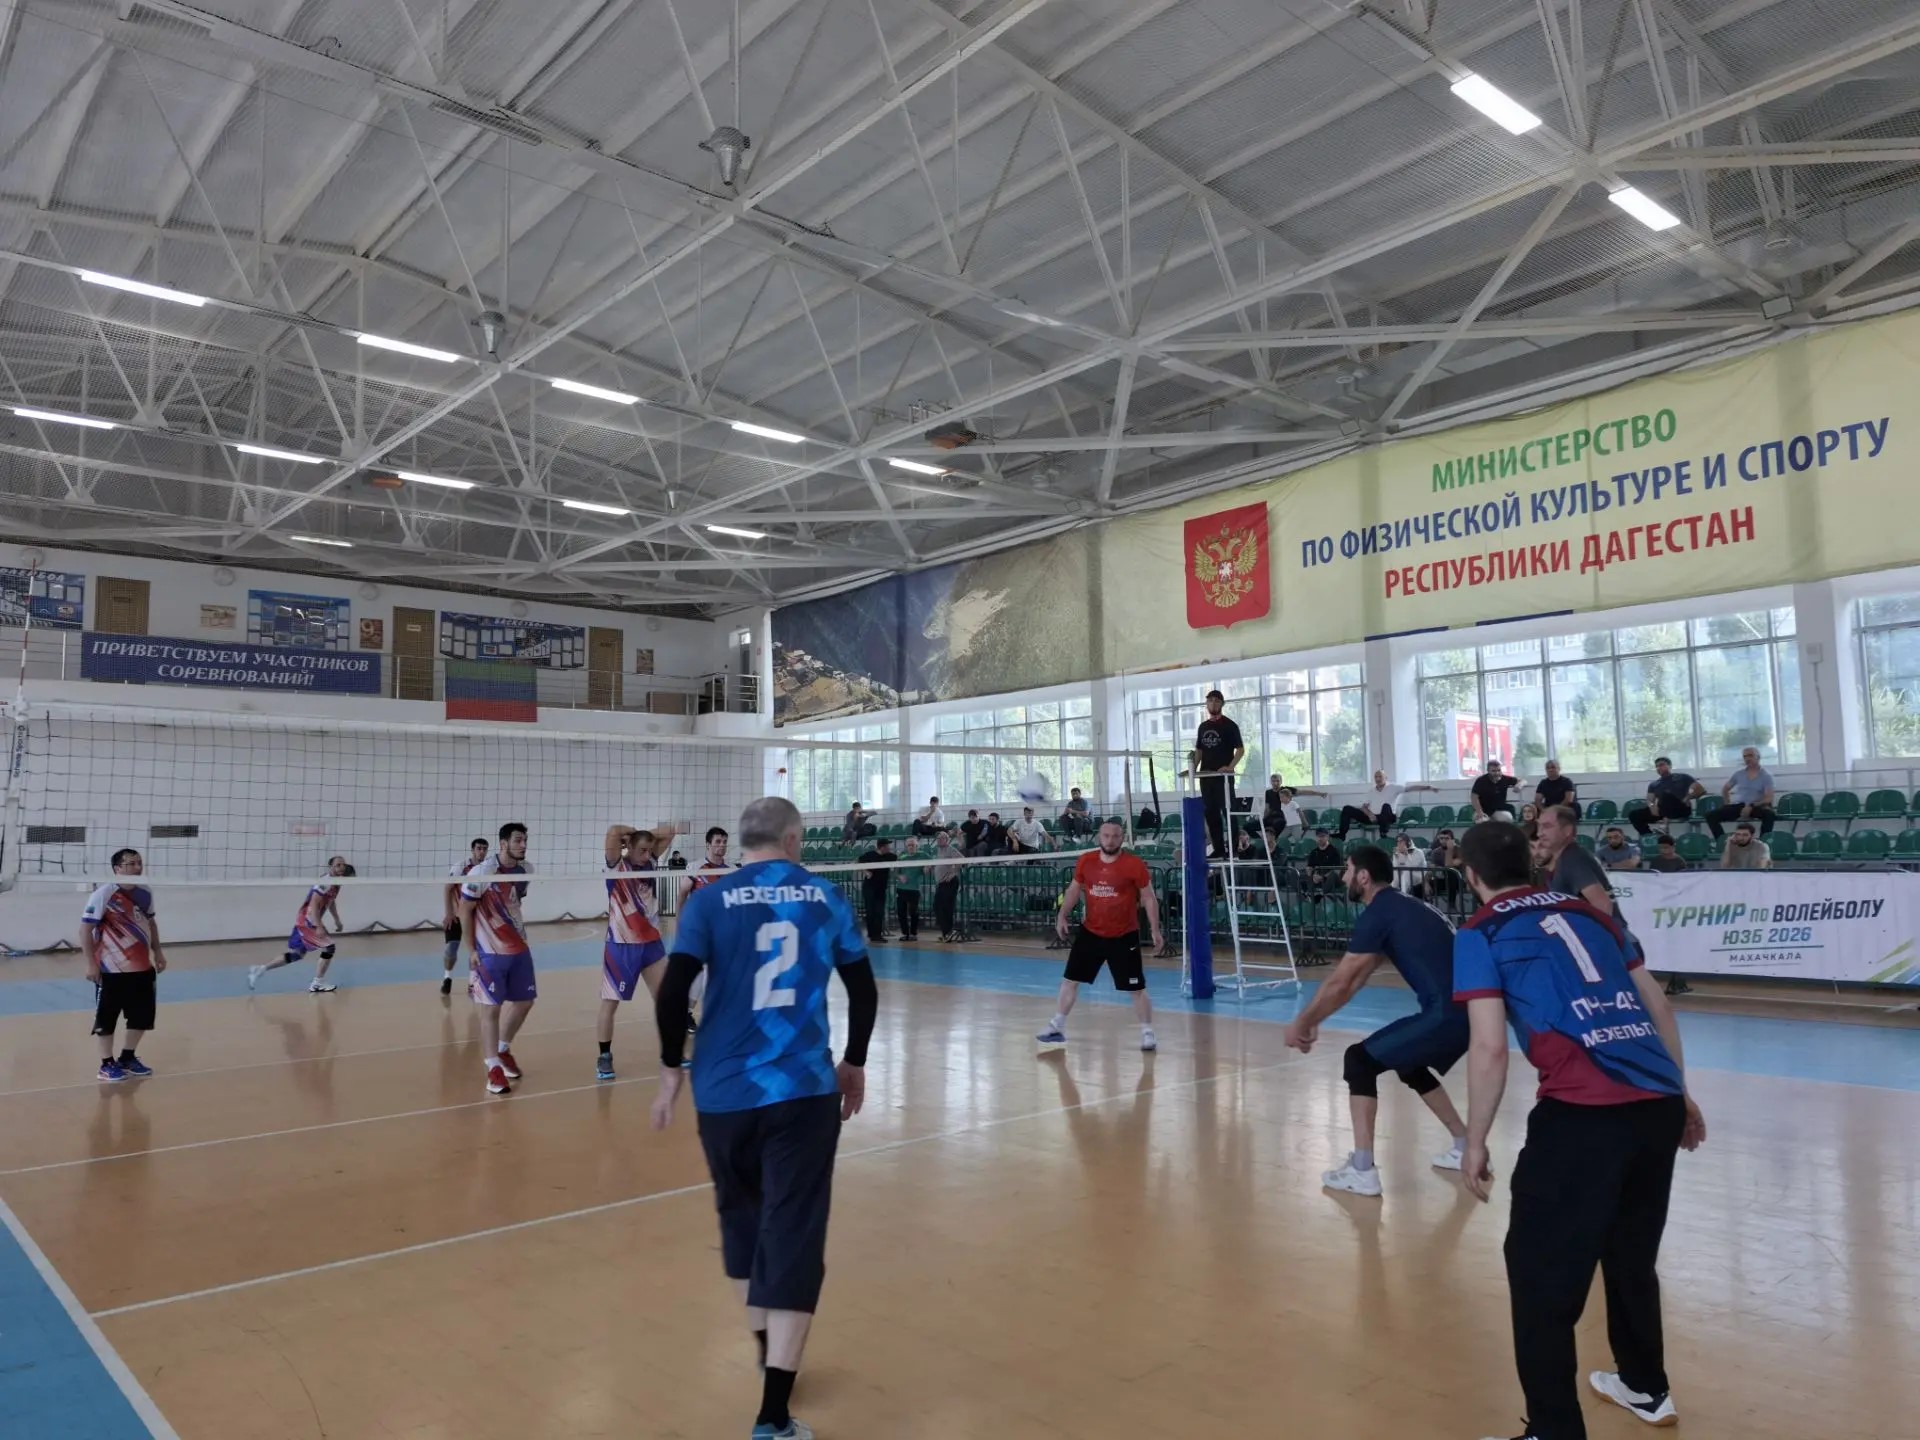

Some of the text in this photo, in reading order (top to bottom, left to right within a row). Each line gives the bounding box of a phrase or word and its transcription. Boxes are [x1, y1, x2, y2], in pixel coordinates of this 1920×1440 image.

[1432, 408, 1677, 493] МИНИСТЕРСТВО
[1301, 416, 1890, 568] ПО ФИЗИЧЕСКОЙ КУЛЬТУРЕ И СПОРТУ
[1384, 505, 1755, 599] РЕСПУБЛИКИ ДАГЕСТАН
[92, 641, 369, 672] ПРИВЕТСТВУЕМ УЧАСТНИКОВ
[157, 664, 315, 686] СОРЕВНОВАНИЙ!
[721, 885, 827, 908] МЕХЕЛЬТА
[1652, 902, 1747, 928] ТУРНИР
[1772, 897, 1885, 923] ВОЛЕЙБОЛУ
[1538, 913, 1603, 983] 1
[1722, 926, 1813, 945] ЮЗБ 2026
[752, 920, 799, 1011] 2
[1729, 952, 1803, 963] МАХАЧКАЛА
[488, 981, 496, 993] 4
